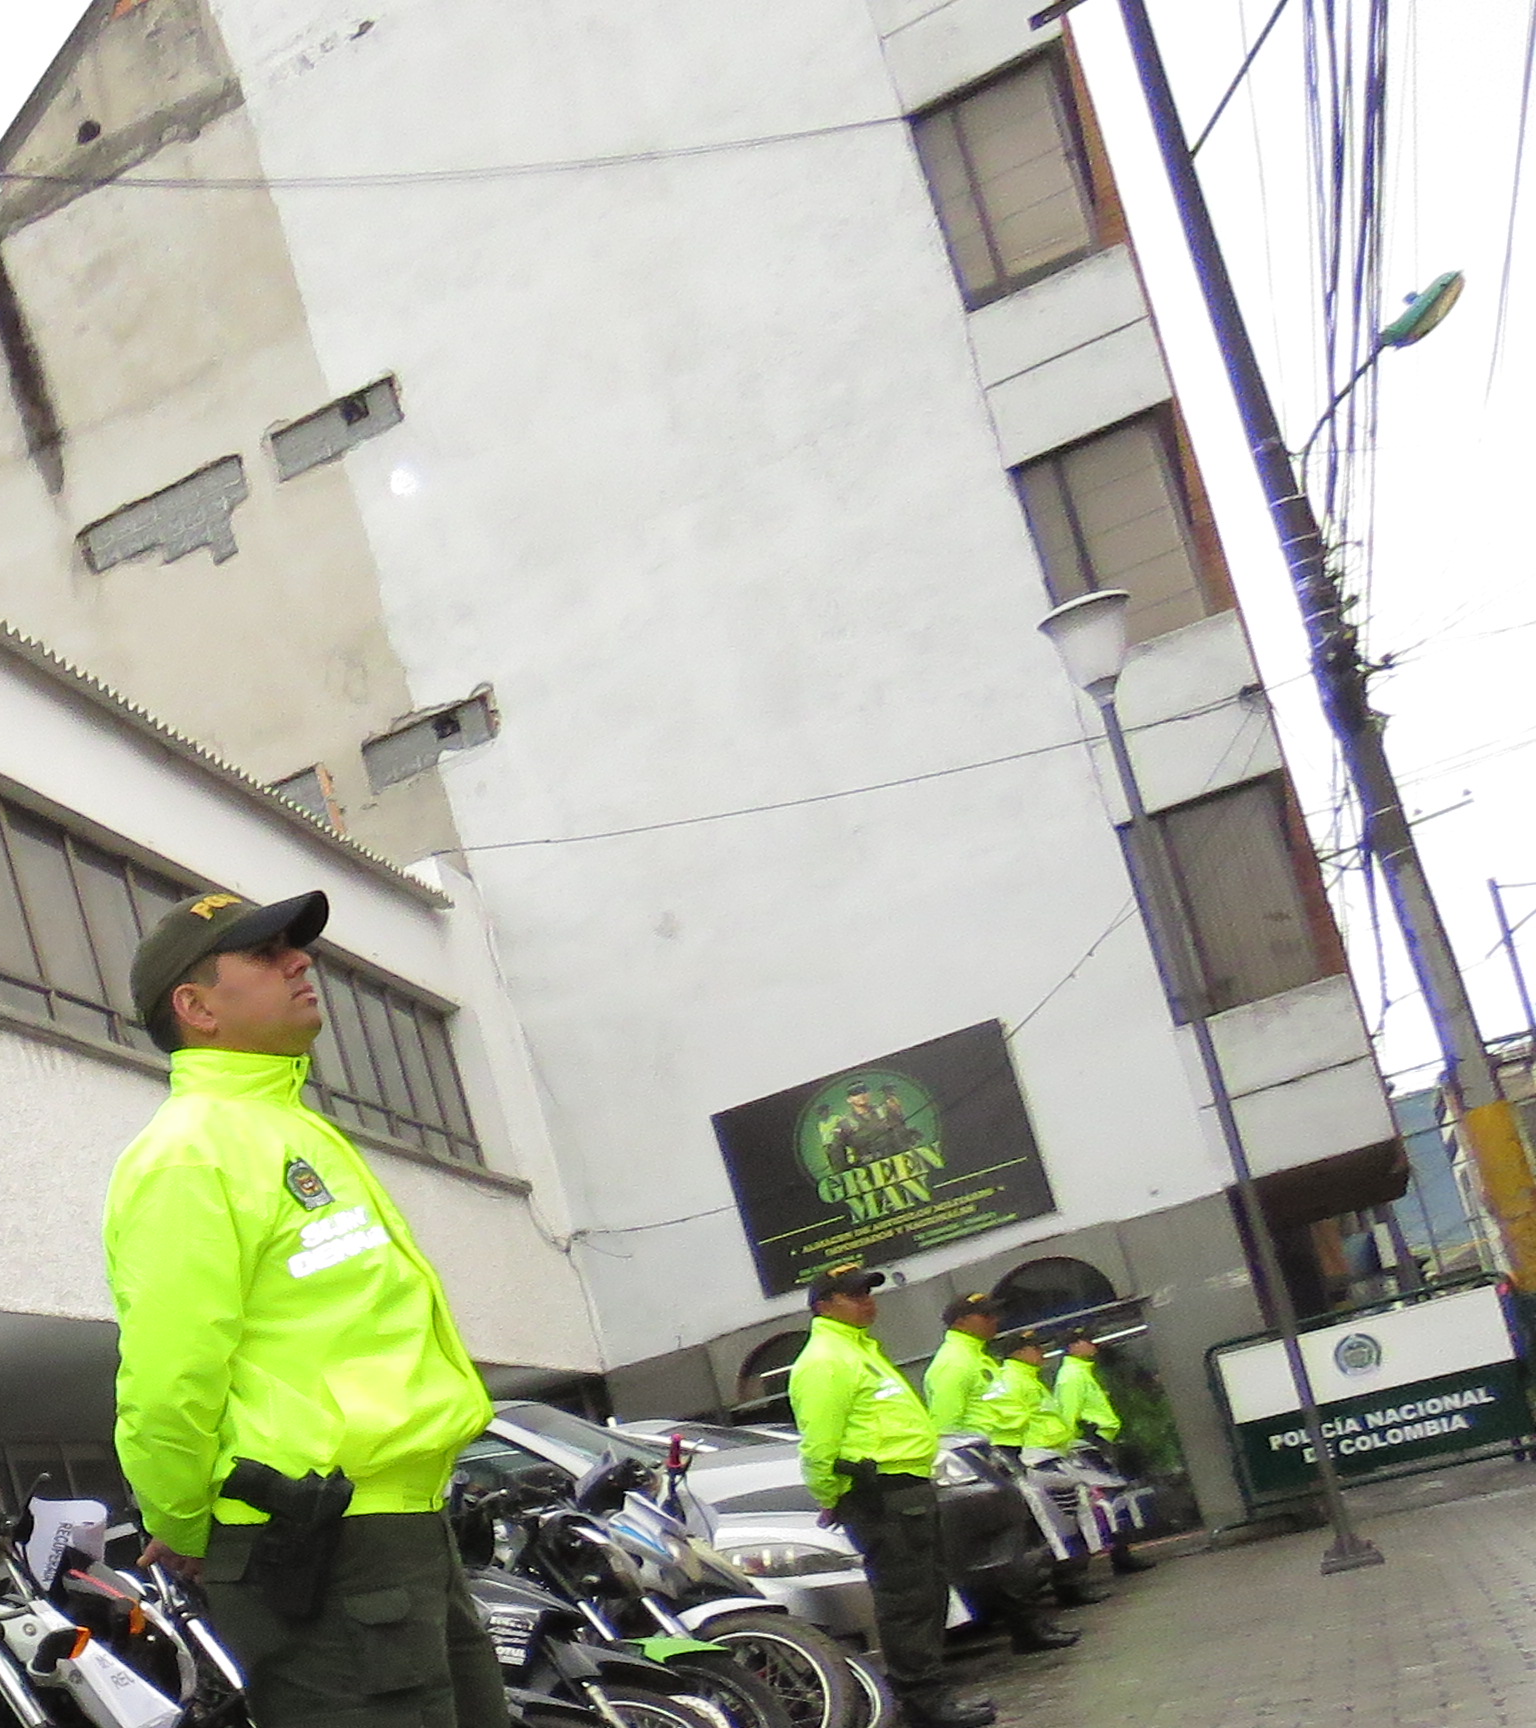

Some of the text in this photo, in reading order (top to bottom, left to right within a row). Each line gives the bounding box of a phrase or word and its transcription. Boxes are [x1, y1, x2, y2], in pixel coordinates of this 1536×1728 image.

[1269, 1386, 1495, 1452] POLCÍA NACIONAL
[1339, 1413, 1470, 1456] COLOMBIA
